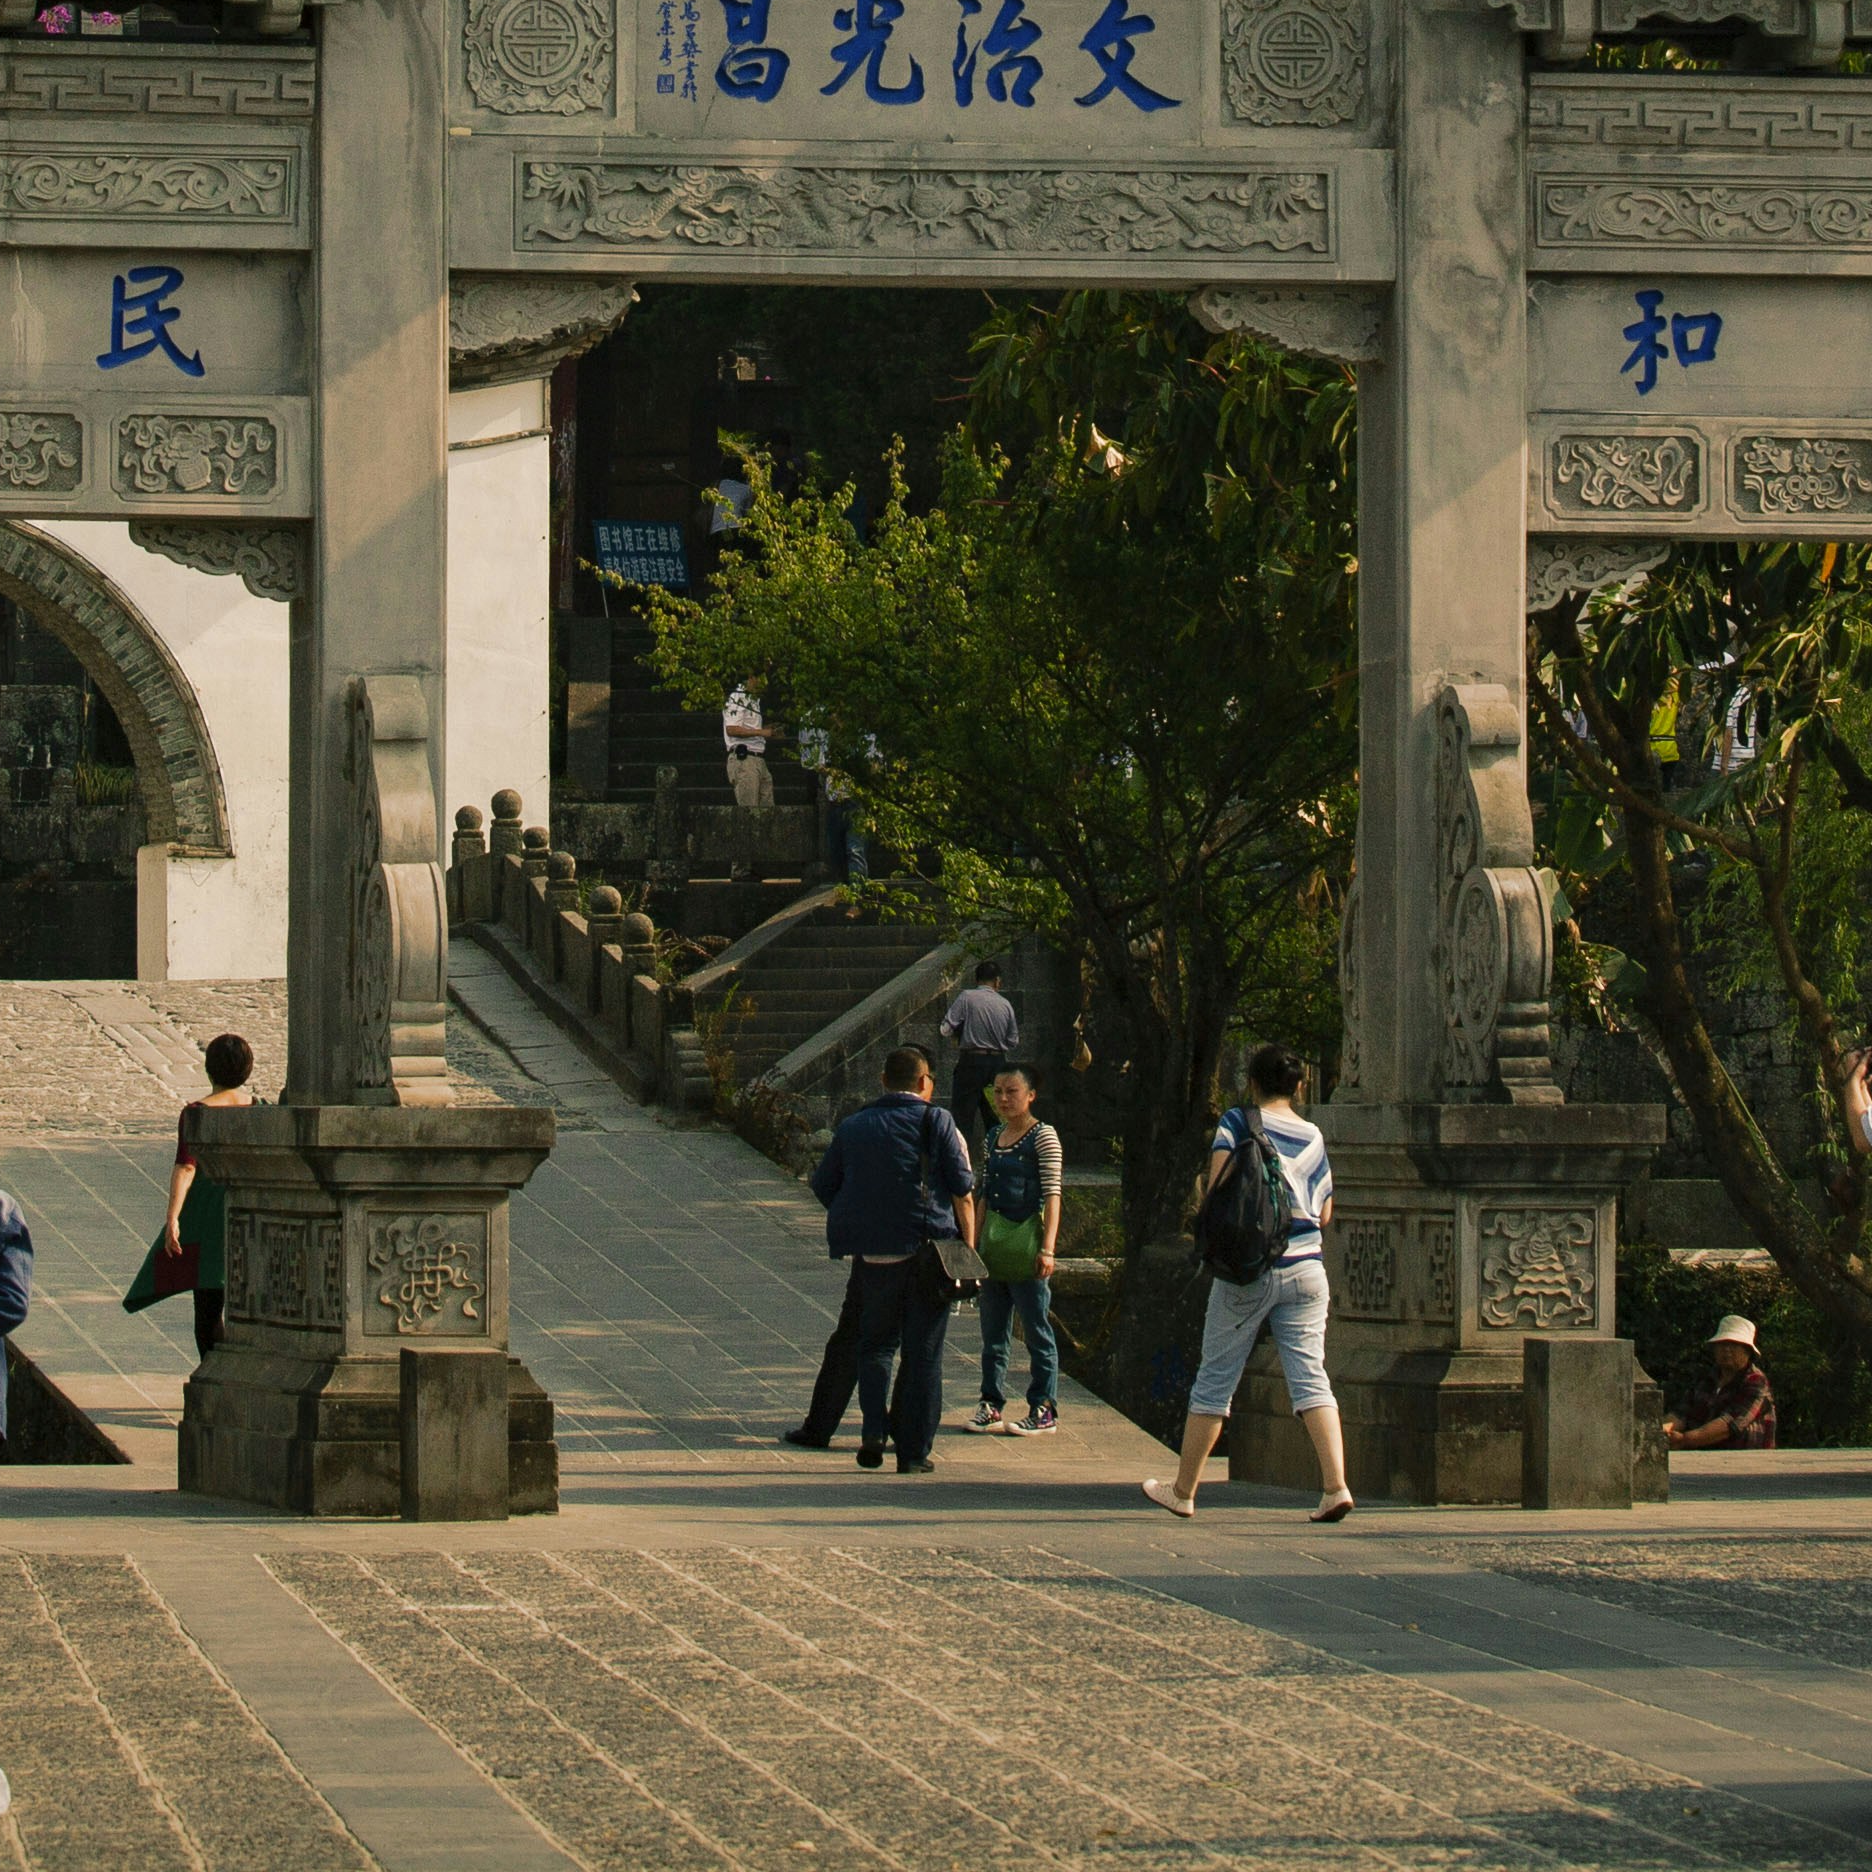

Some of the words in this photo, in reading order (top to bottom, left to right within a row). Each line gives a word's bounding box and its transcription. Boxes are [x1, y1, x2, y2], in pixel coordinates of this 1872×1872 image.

[599, 526, 680, 553] 图书馆正在维修
